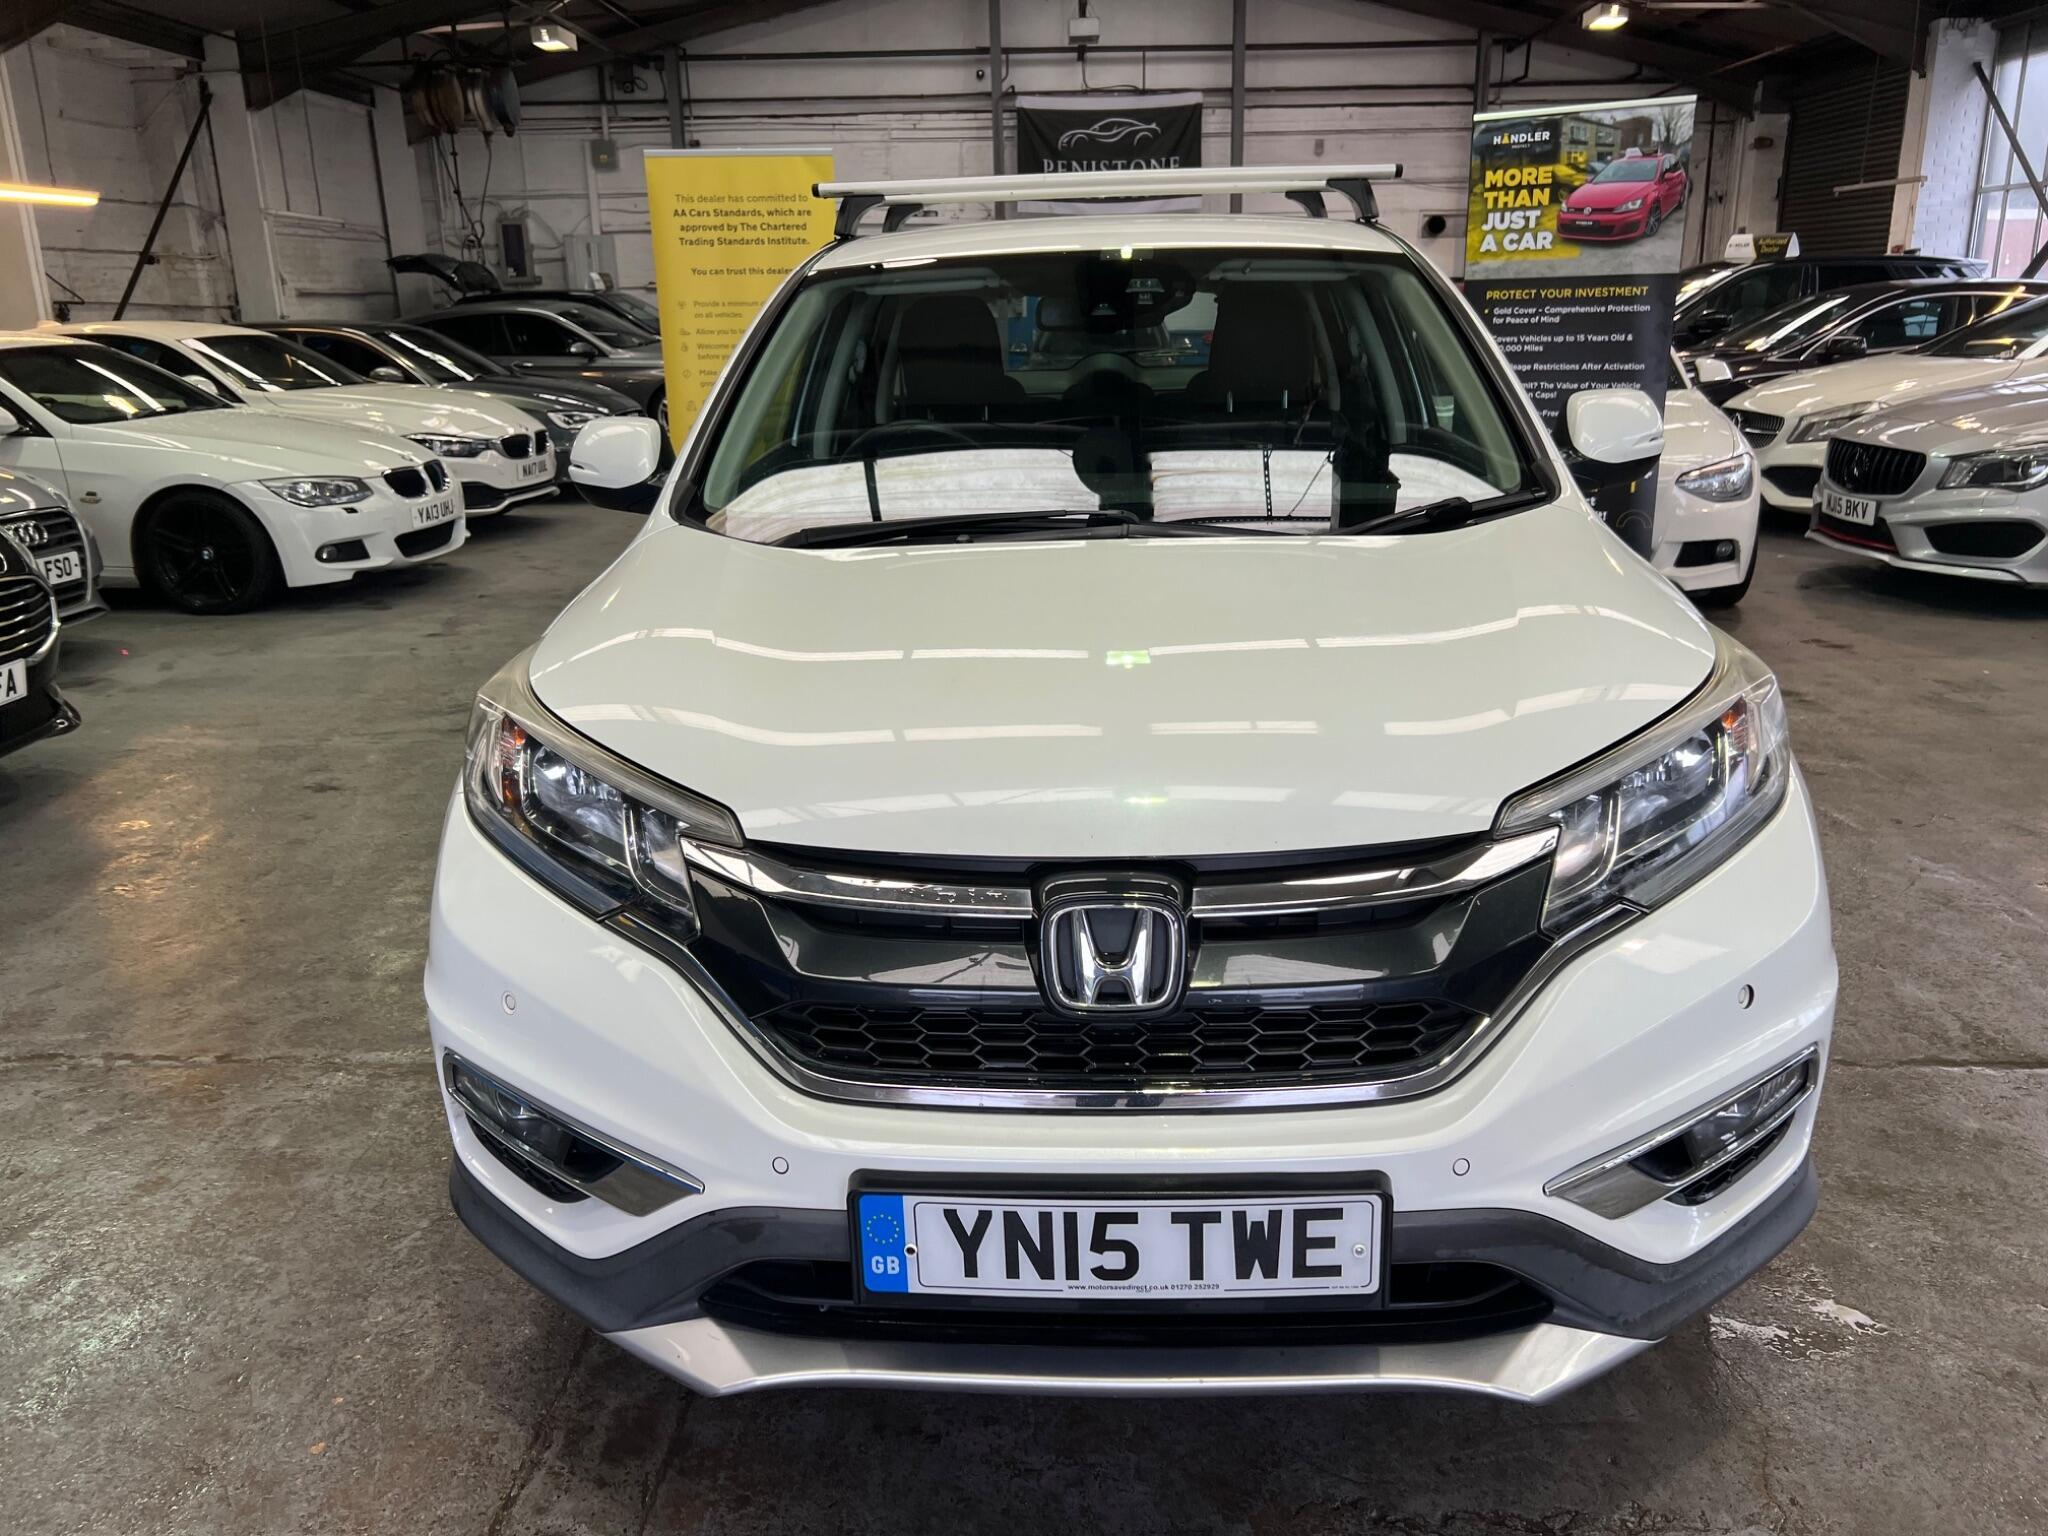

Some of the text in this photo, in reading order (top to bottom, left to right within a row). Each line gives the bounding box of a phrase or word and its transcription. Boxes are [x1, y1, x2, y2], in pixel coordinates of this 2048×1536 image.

[1042, 156, 1181, 174] PENISTONE
[1485, 166, 1553, 188] MORE
[674, 194, 808, 203] This dealer has committed to
[1484, 188, 1550, 209] THAN
[673, 208, 687, 218] AA
[689, 208, 711, 218] Cars
[713, 208, 765, 218] Standards,
[767, 208, 794, 217] which
[1481, 209, 1541, 231] JUST
[680, 222, 807, 232] approved by The Chartered
[678, 237, 810, 248] Trading Standards Institute.
[1480, 231, 1553, 252] A CAR
[691, 268, 708, 276] You
[726, 268, 747, 276] trust
[1486, 286, 1649, 300] PROTECT YOUR INVESTMENT
[1493, 307, 1512, 315] Gold
[1514, 306, 1536, 314] Cover
[1544, 305, 1606, 315] Comprehensive
[1607, 304, 1651, 312] Protection
[1493, 316, 1504, 324] for
[1506, 316, 1529, 324] Peace
[1540, 315, 1560, 323] Mind
[1520, 334, 1552, 343] Vehicles
[1554, 335, 1564, 344] up
[1576, 334, 1585, 342] 15
[1587, 334, 1608, 342] Years
[1610, 334, 1625, 342] Old
[1524, 344, 1543, 352] Miles
[1533, 362, 1580, 371] Restrictions
[1582, 362, 1602, 370] After
[1604, 362, 1645, 370] Activation
[1556, 382, 1578, 390] Value
[1535, 391, 1557, 400] Caps!
[417, 504, 440, 524] YA13
[1845, 499, 1868, 520] BKV
[943, 1207, 1343, 1281] YN15 TWE
[871, 1255, 900, 1275] GB
